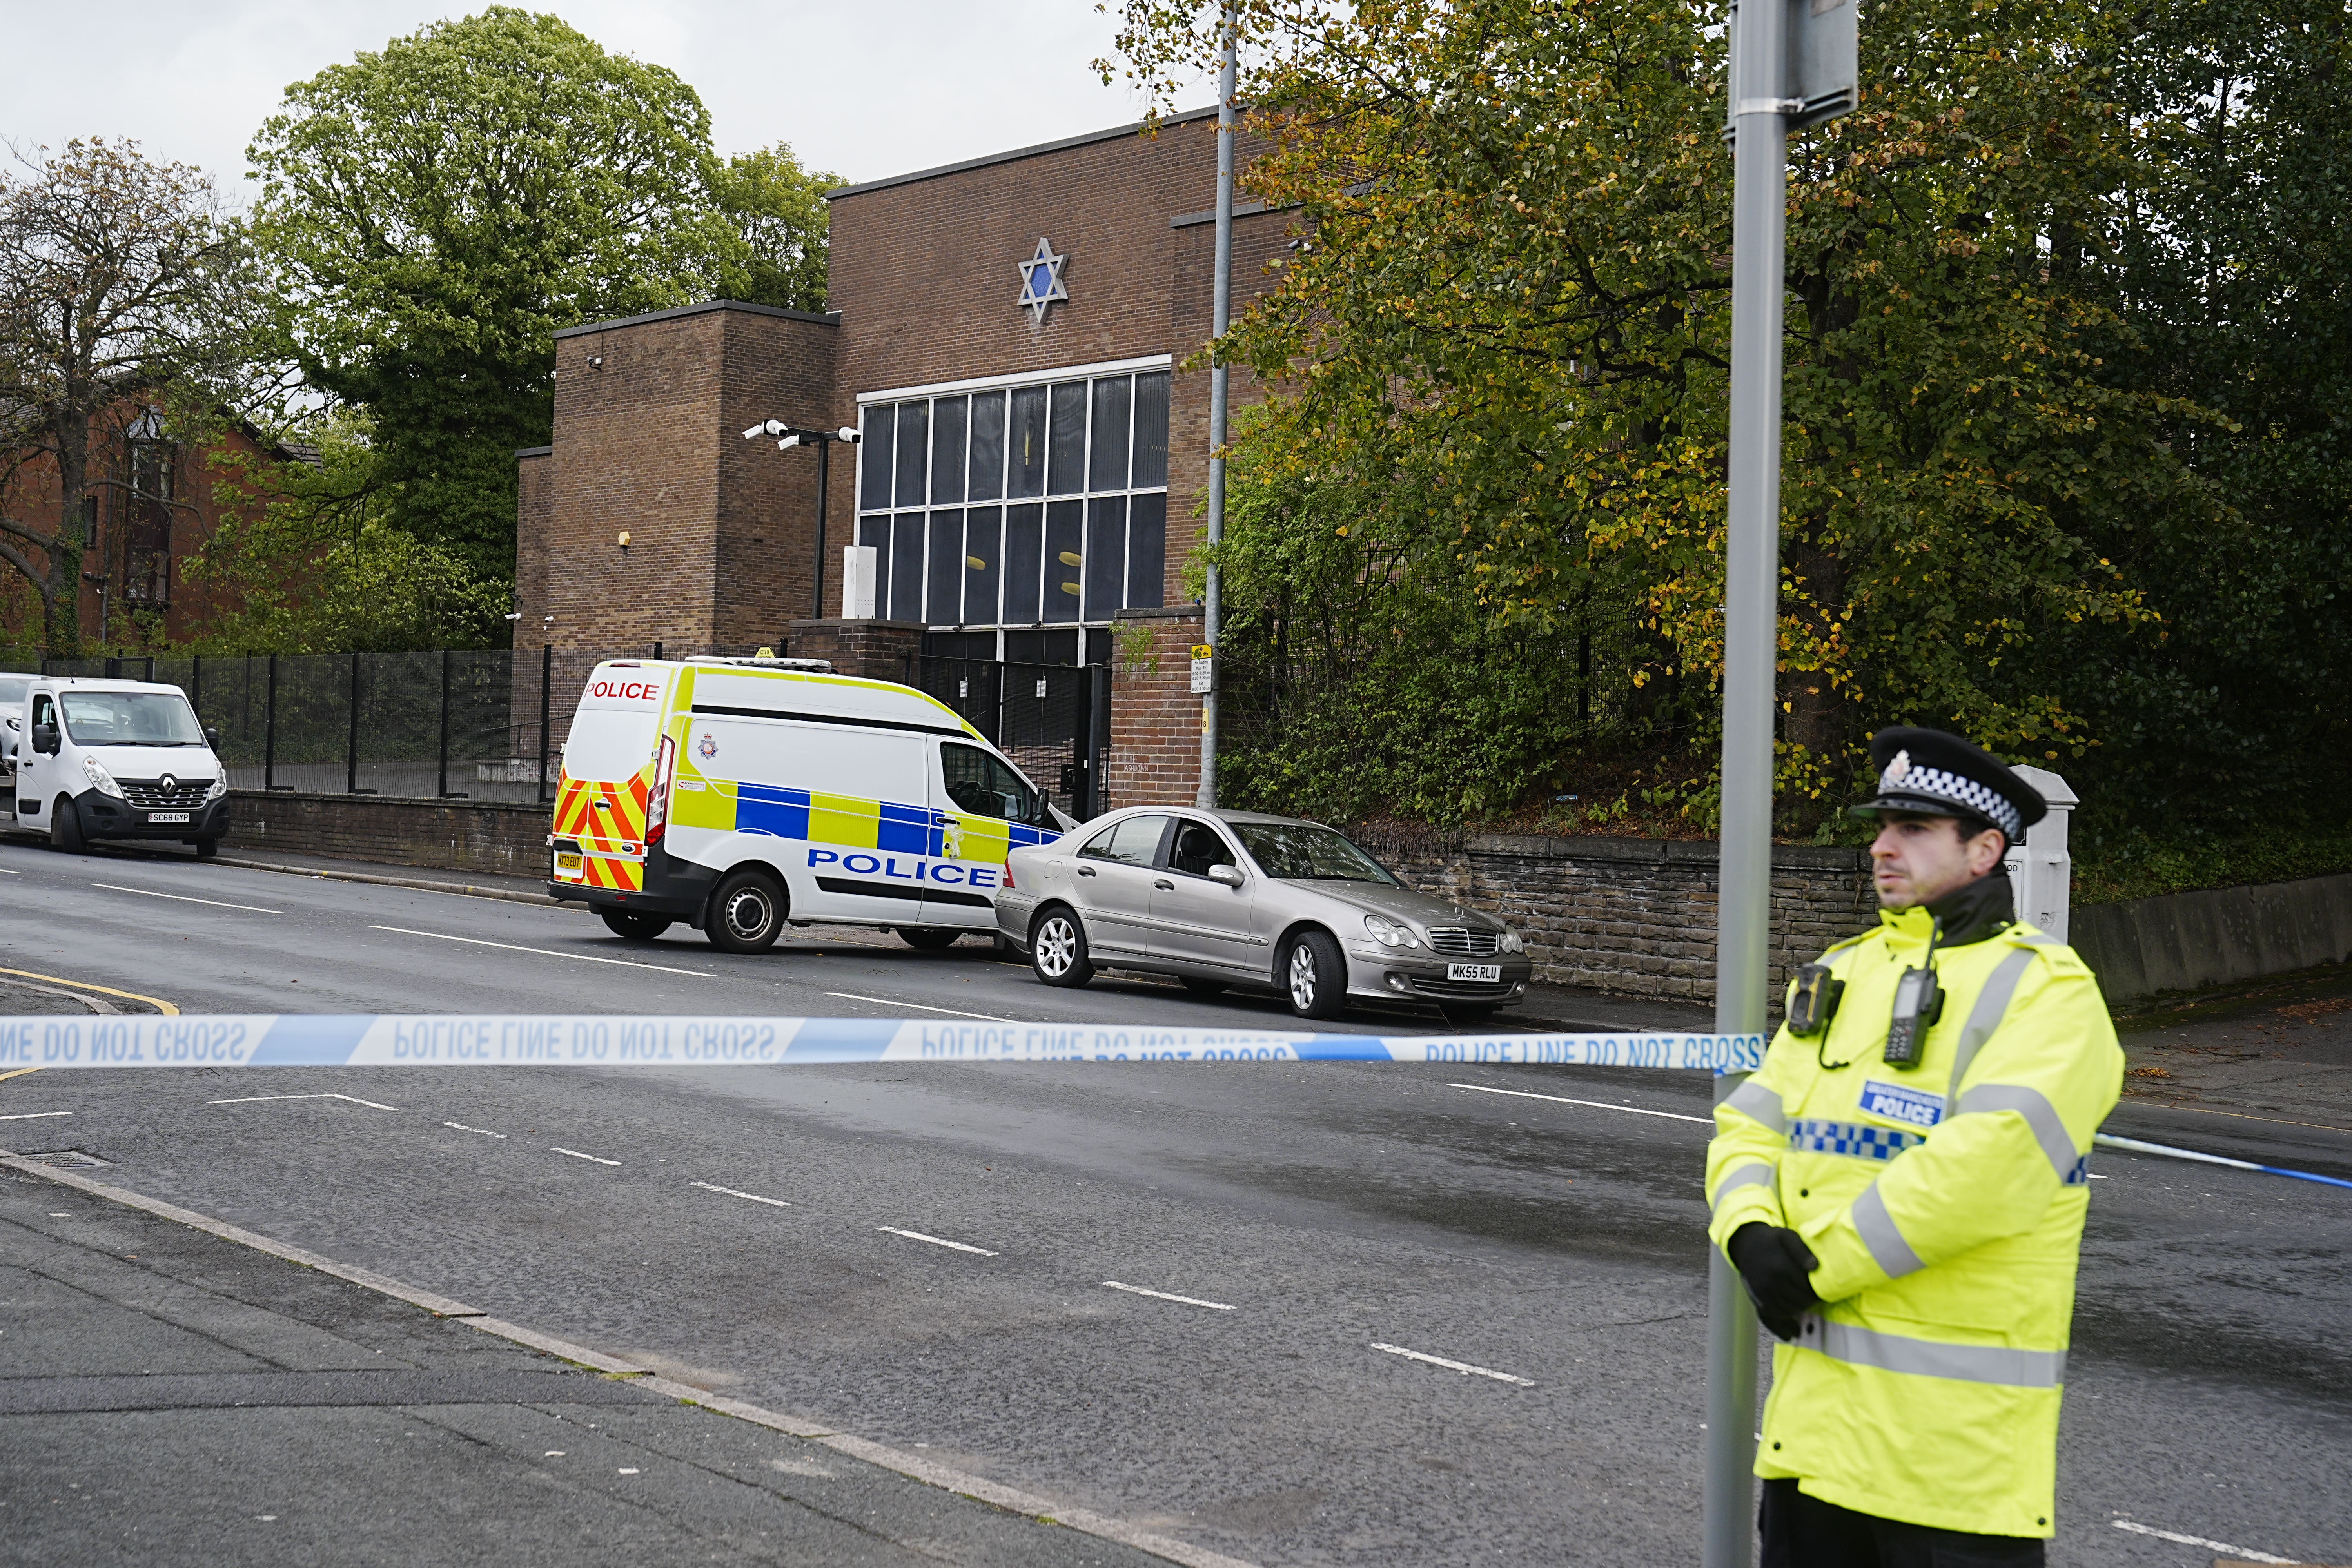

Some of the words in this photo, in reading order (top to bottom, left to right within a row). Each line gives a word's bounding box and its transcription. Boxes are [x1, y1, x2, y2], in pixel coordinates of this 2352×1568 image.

[584, 682, 659, 700] POLICE
[559, 855, 569, 866] MX73
[570, 857, 580, 867] EUT
[807, 849, 997, 888] POLICE
[1453, 965, 1478, 978] MK55
[1480, 967, 1497, 979] RLU
[1628, 1039, 1675, 1068] NOT
[1684, 1037, 1759, 1069] CROSS
[1871, 1095, 1936, 1126] POLICE
